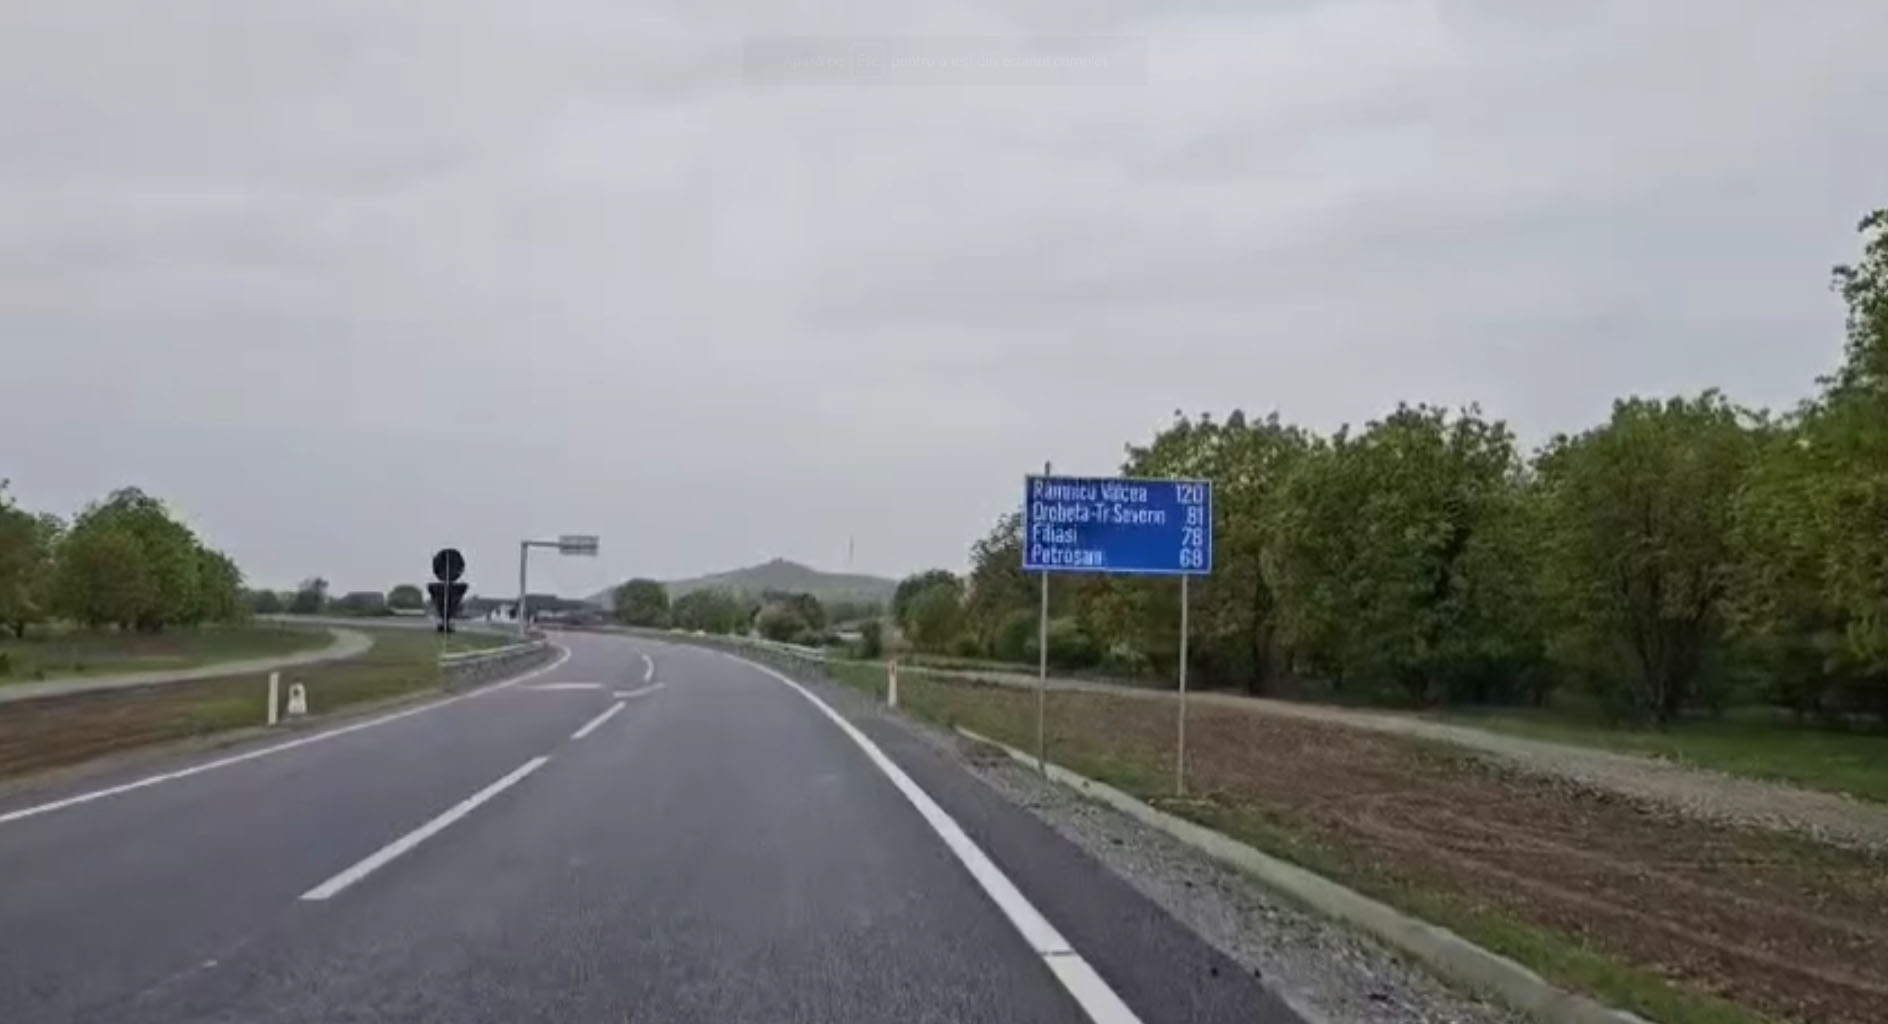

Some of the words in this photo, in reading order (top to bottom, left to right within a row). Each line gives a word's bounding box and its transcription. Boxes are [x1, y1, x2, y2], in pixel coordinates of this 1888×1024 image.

[1176, 483, 1204, 504] 120
[1187, 506, 1204, 526] 81
[1182, 526, 1204, 546] 78
[1179, 547, 1204, 568] 68
